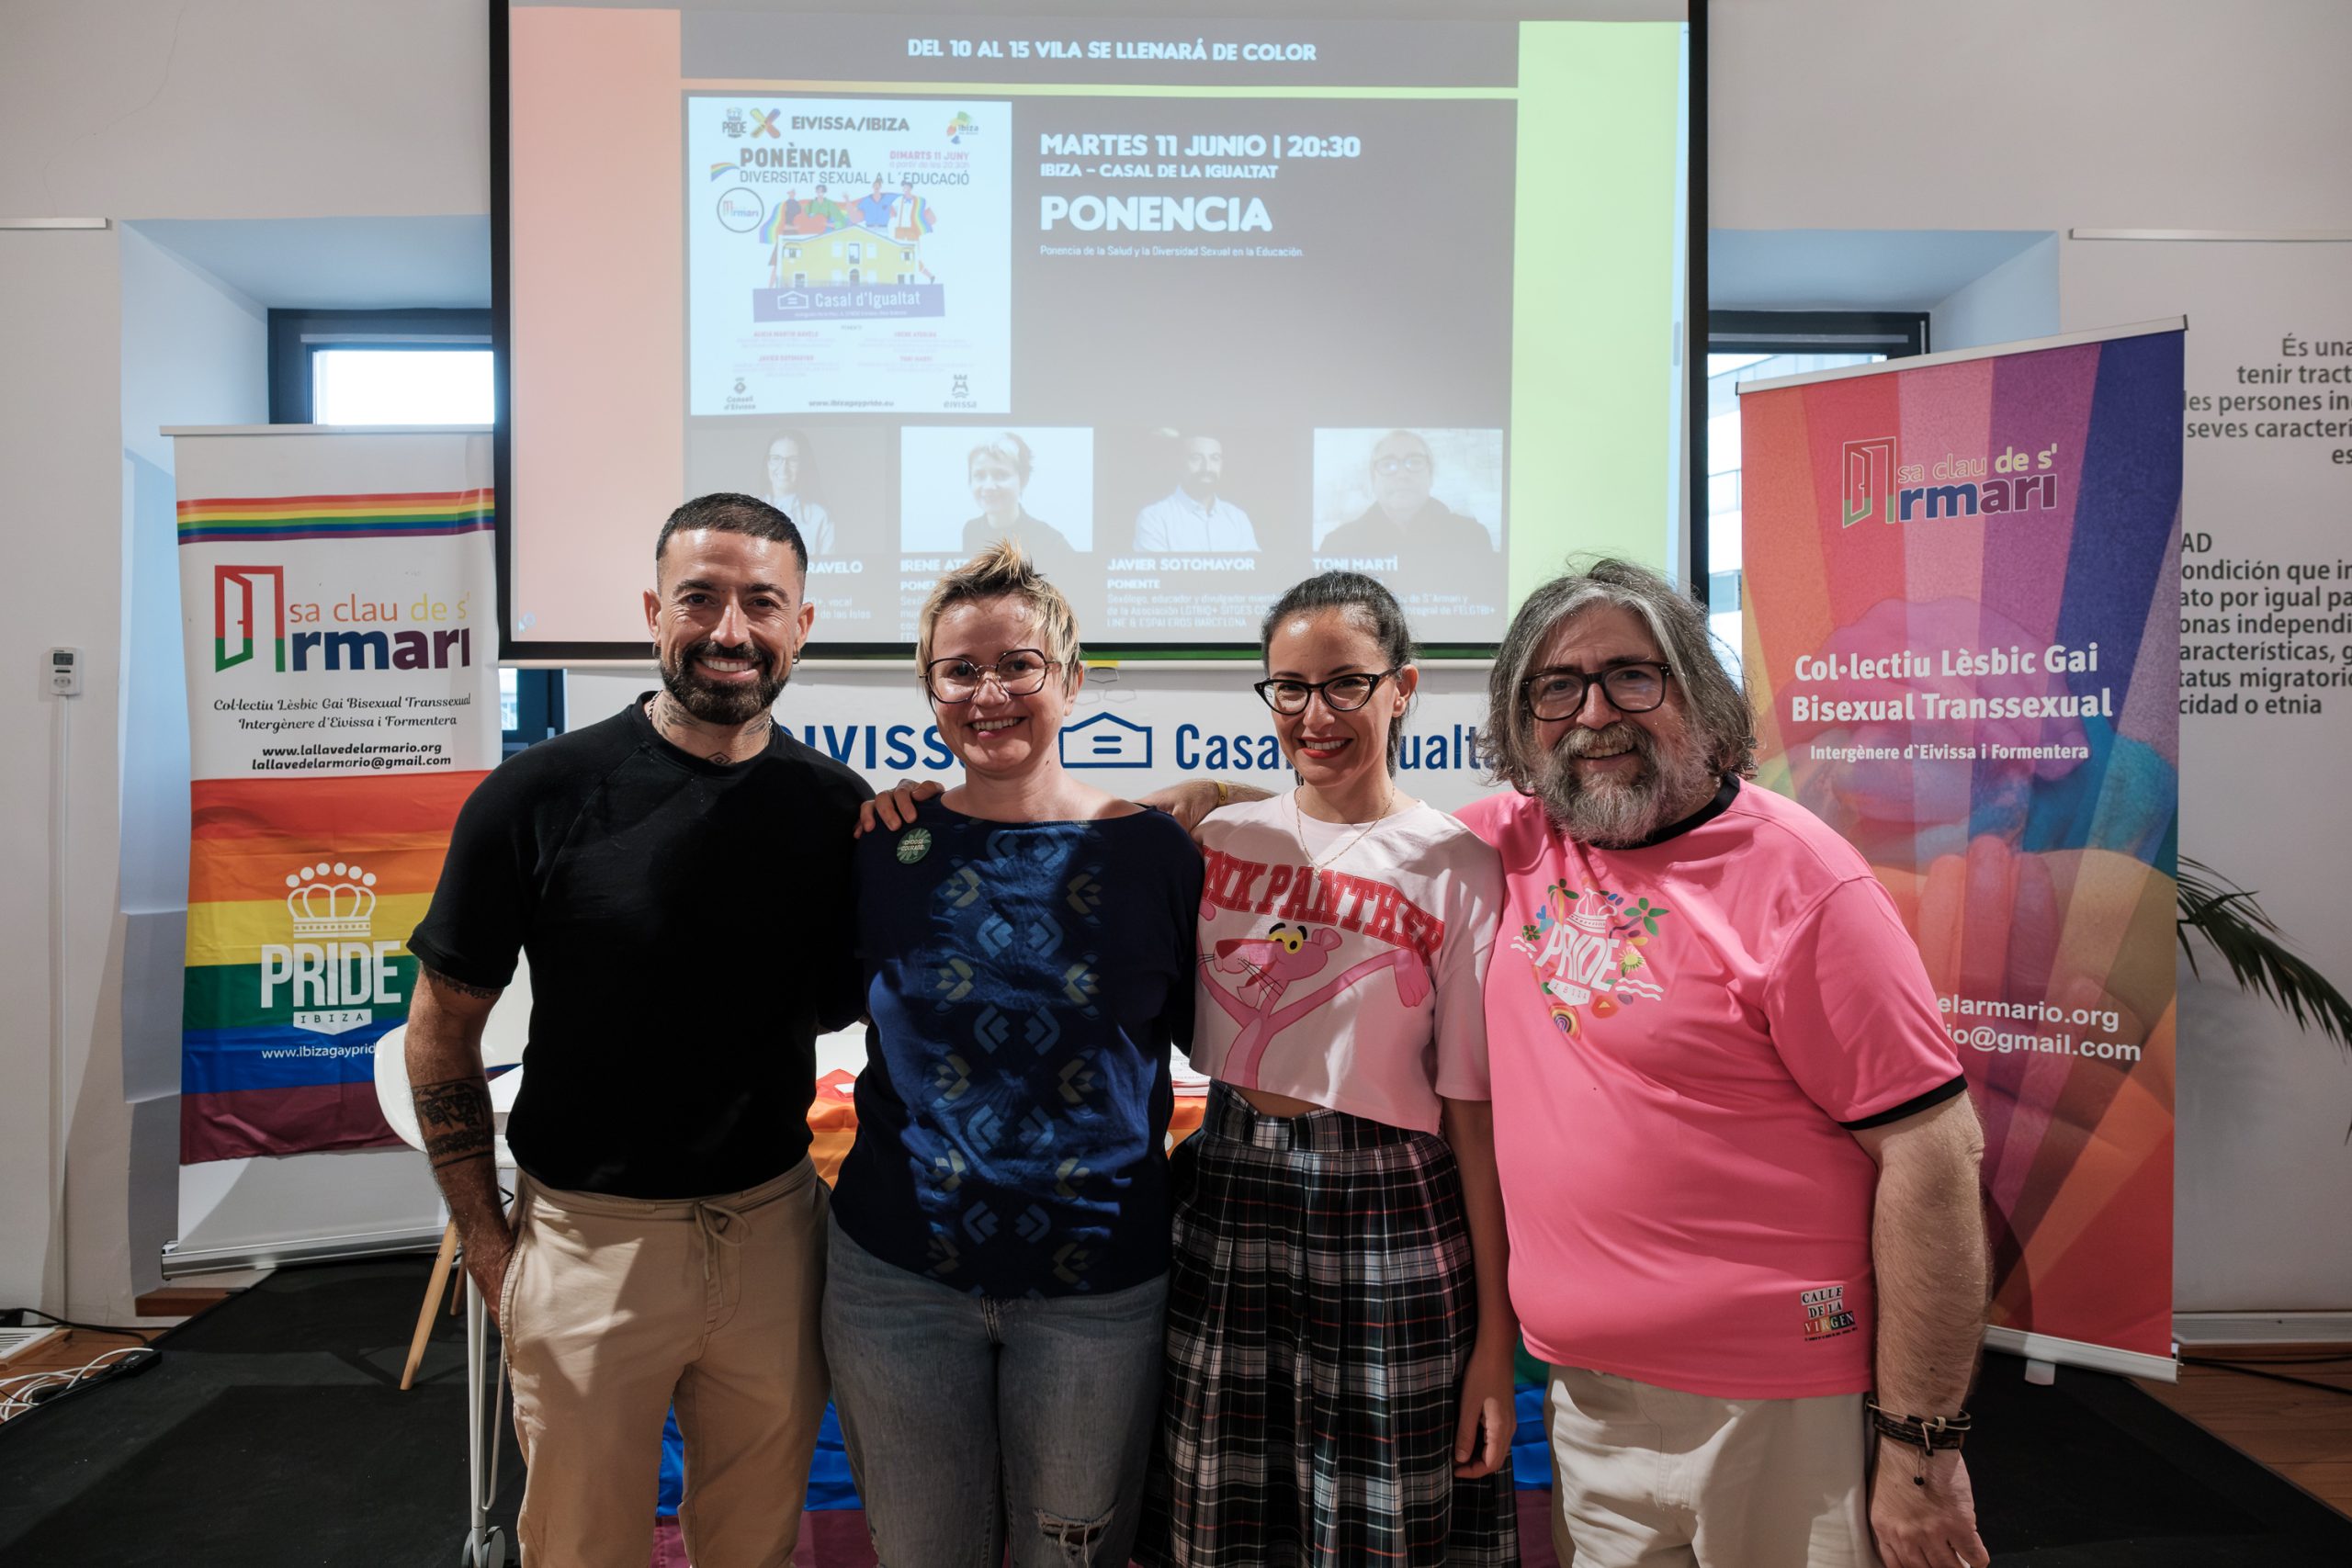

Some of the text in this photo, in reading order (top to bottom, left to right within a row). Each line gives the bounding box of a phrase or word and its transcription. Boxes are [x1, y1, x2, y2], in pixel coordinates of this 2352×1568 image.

[908, 38, 1317, 62] DEL 10 AL 15 VILA SE LLENARÁ DE COLOR
[791, 116, 910, 132] EIVISSA/IBIZA
[740, 142, 852, 169] PONÈNCIA
[889, 151, 970, 161] DIMARTS 11 JUNY
[1040, 133, 1361, 158] MARTES 11 JUNIO 20:30
[740, 170, 815, 184] DIVERSITAT
[819, 171, 871, 185] SEXUAL
[1040, 164, 1278, 179] IBIZA CASAL DE LA IGUALTAT
[1040, 194, 1273, 232] PONENCIA
[1040, 245, 1081, 256] Ponencia
[1083, 245, 1095, 256] de
[1096, 245, 1105, 256] la
[1107, 245, 1132, 256] Salud
[1134, 247, 1140, 258] y
[1141, 245, 1150, 256] la
[1152, 245, 1199, 256] Diversidad
[1201, 245, 1231, 257] Sexual
[1233, 247, 1244, 257] en
[1245, 246, 1255, 257] la
[815, 289, 921, 309] Casal d'Igualtat
[2281, 333, 2309, 357] És
[2236, 363, 2293, 384] tenir
[2219, 394, 2323, 417] persones
[2328, 389, 2352, 412] in
[2187, 422, 2249, 438] seves
[1898, 462, 1925, 484] sa
[1932, 453, 1987, 480] clau
[1995, 446, 2030, 473] de
[2181, 532, 2212, 553] AD
[900, 558, 941, 572] IRENE
[1107, 558, 1256, 571] JAVIER SOTOMAYOR
[1312, 555, 1398, 571] TONI MARTÍ
[2181, 558, 2280, 581] ondición
[2287, 563, 2331, 585] que
[1107, 579, 1161, 590] PONENTE
[289, 602, 321, 624] sa
[333, 593, 398, 623] clau
[411, 592, 447, 621] de
[2180, 588, 2214, 607] ato
[2220, 591, 2259, 613] por
[2264, 585, 2322, 613] igual
[2179, 617, 2231, 634] onas
[1941, 646, 2037, 677] Lèsbic
[2043, 642, 2098, 673] Gai
[2178, 640, 2335, 664] aracterísticas,
[2178, 669, 2232, 687] tatus
[277, 697, 319, 712] Lèsbic
[322, 697, 344, 710] Gai
[346, 696, 402, 710] Bisexual
[405, 693, 471, 709] Transsexual
[1792, 687, 2113, 722] Bisexual Transsexual
[2178, 693, 2323, 715] cidad o etnia
[238, 718, 315, 735] Intergènere
[377, 717, 381, 728] i
[384, 715, 458, 728] Formentera
[263, 742, 443, 759] www.lallavedelarmario.org
[780, 724, 965, 771] IVISS
[1175, 723, 1295, 771] Casa
[1810, 744, 1899, 763] Intergènere
[1981, 743, 1986, 760] i
[1991, 743, 2088, 760] Formentera
[252, 754, 452, 771] lallavedelarmario@gmail.com
[1203, 845, 1268, 912] NK
[1534, 921, 1621, 992] PRIDE
[260, 940, 402, 1009] PRIDE
[300, 1013, 364, 1024] IBIZA
[1937, 994, 2120, 1032] elarmario.org
[1946, 1023, 2141, 1062] io@gmail.com
[1802, 1286, 1843, 1303] CALLE
[1808, 1301, 1842, 1318] DE LA
[1804, 1313, 1855, 1333] VIRGEN
